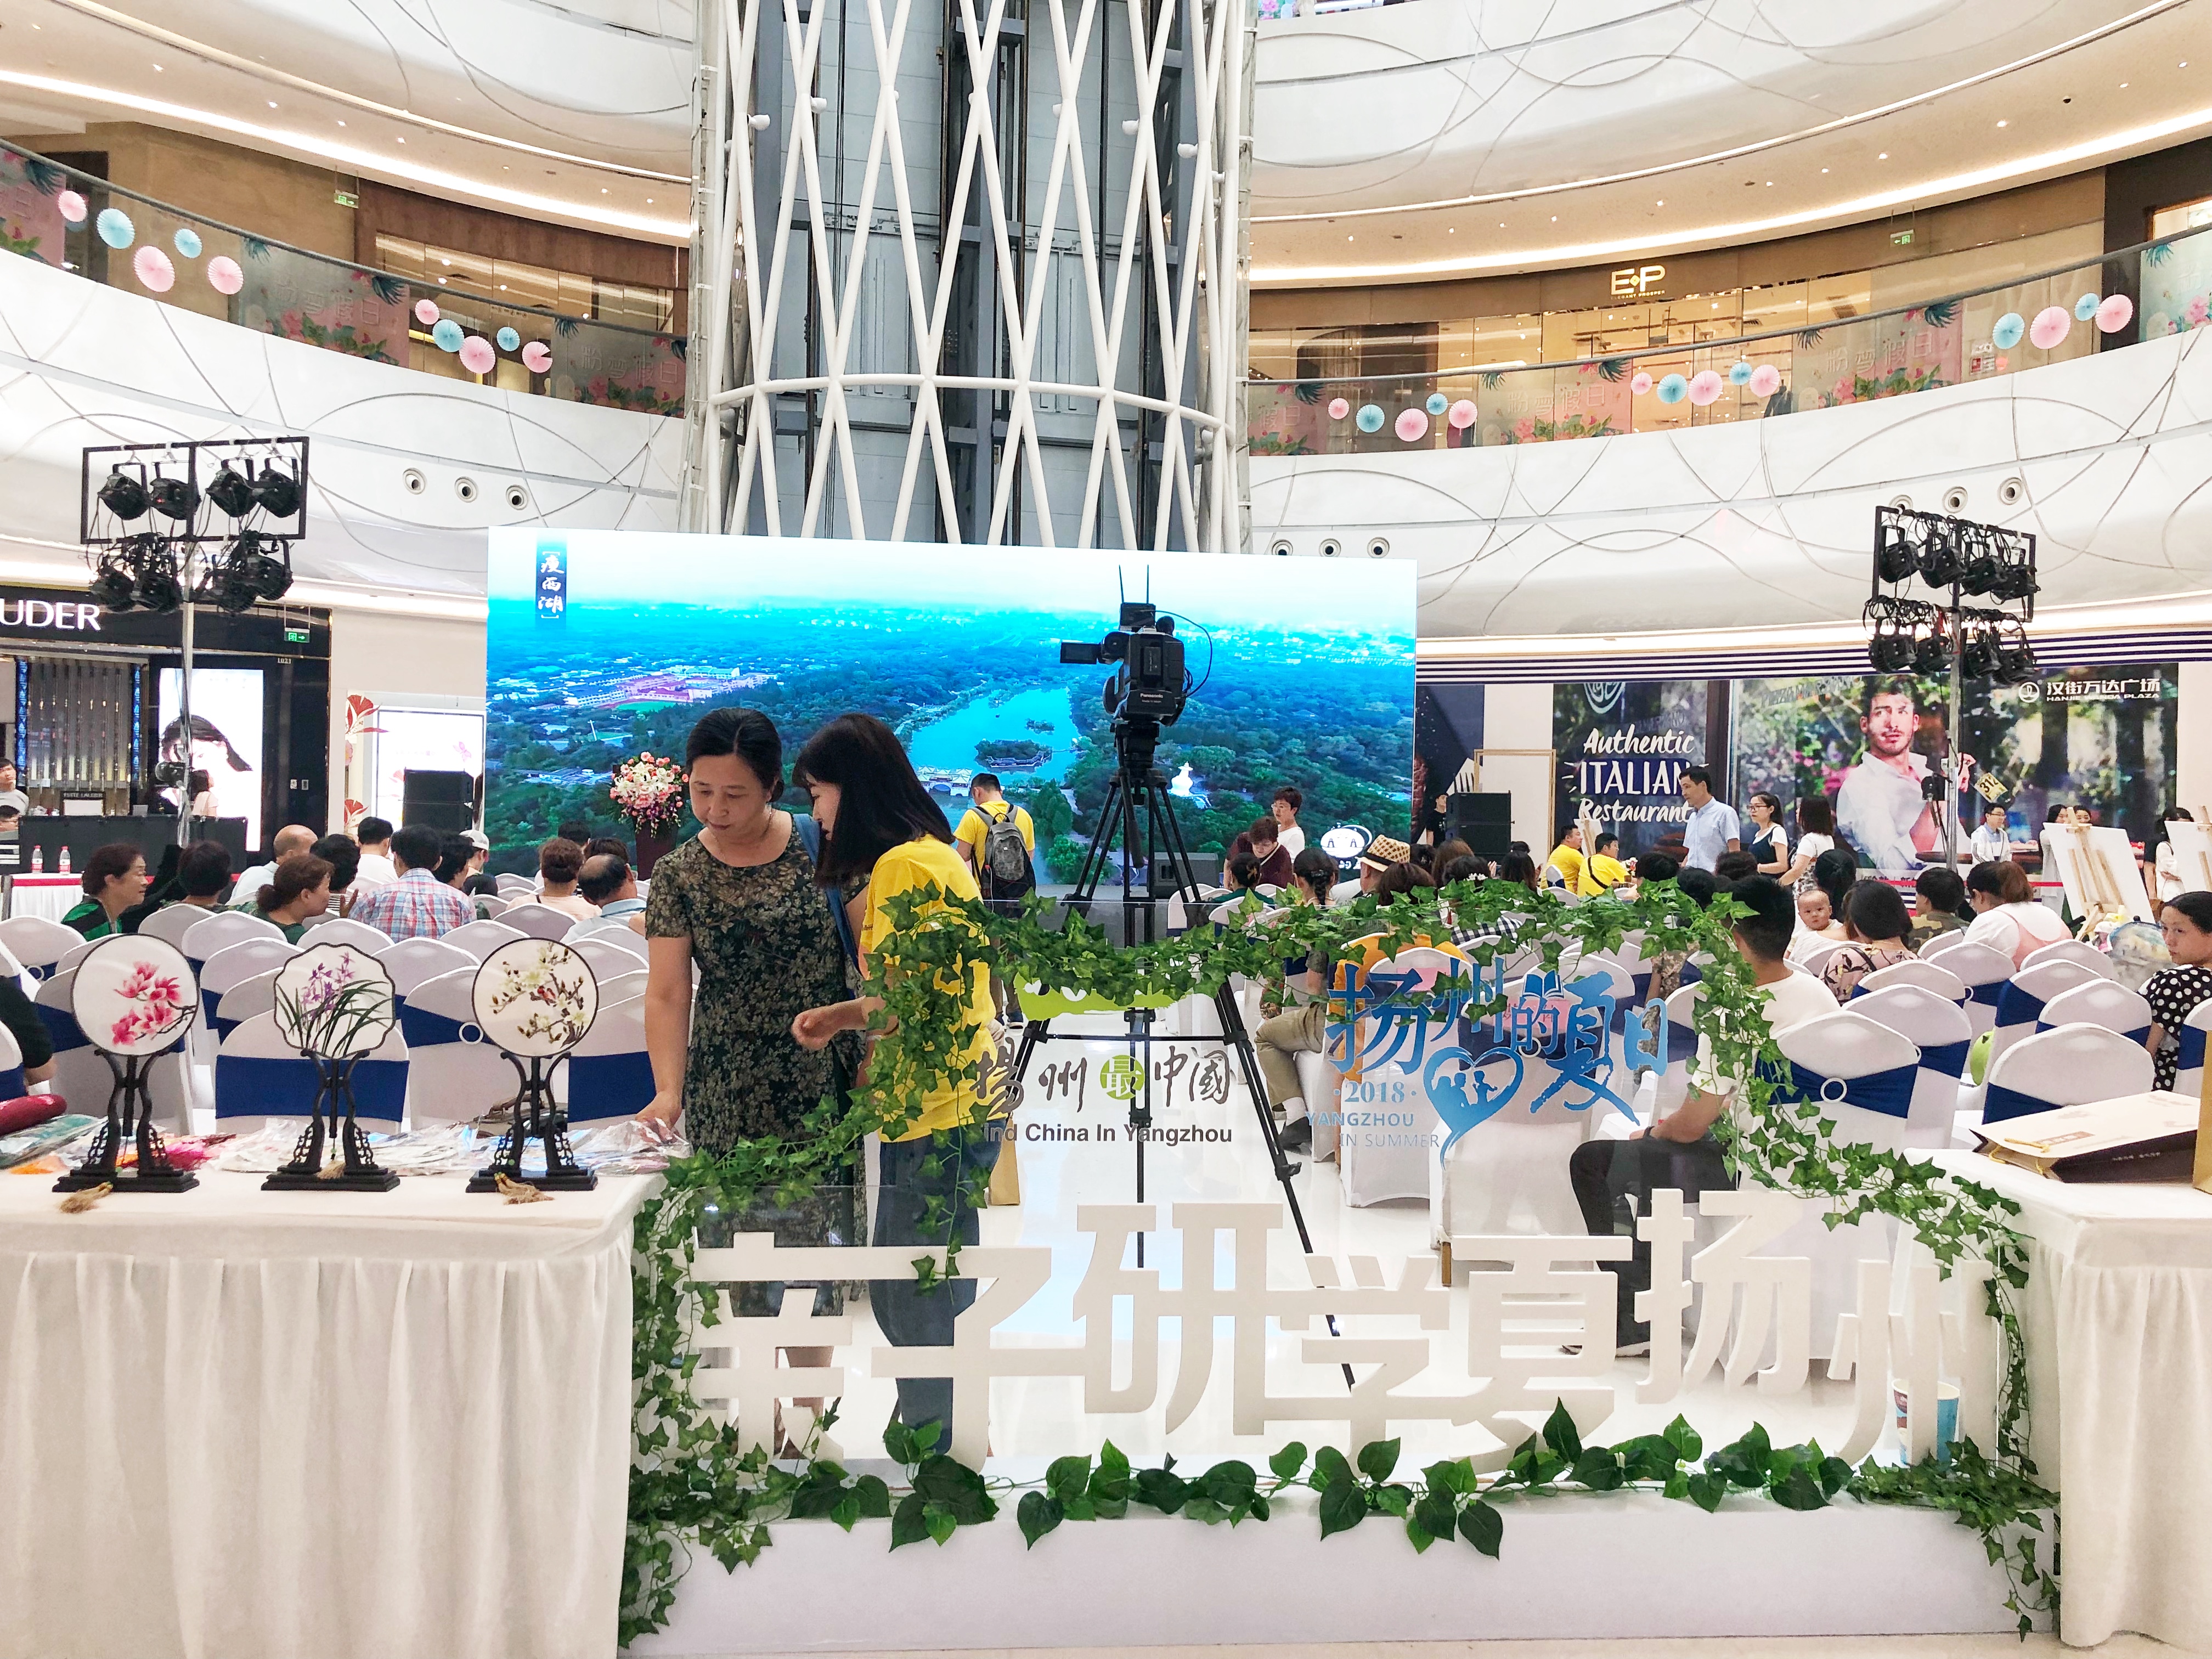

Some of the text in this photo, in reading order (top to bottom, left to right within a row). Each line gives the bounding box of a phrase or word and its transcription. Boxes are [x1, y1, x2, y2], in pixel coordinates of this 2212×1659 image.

[2047, 678, 2160, 696] 汉街万达广场
[1583, 724, 1695, 754] Authentic
[1305, 1111, 1414, 1127] YANGZHOU
[983, 1123, 1232, 1147] ind China In Yangzhou
[1339, 1132, 1440, 1148] IN SUMMER
